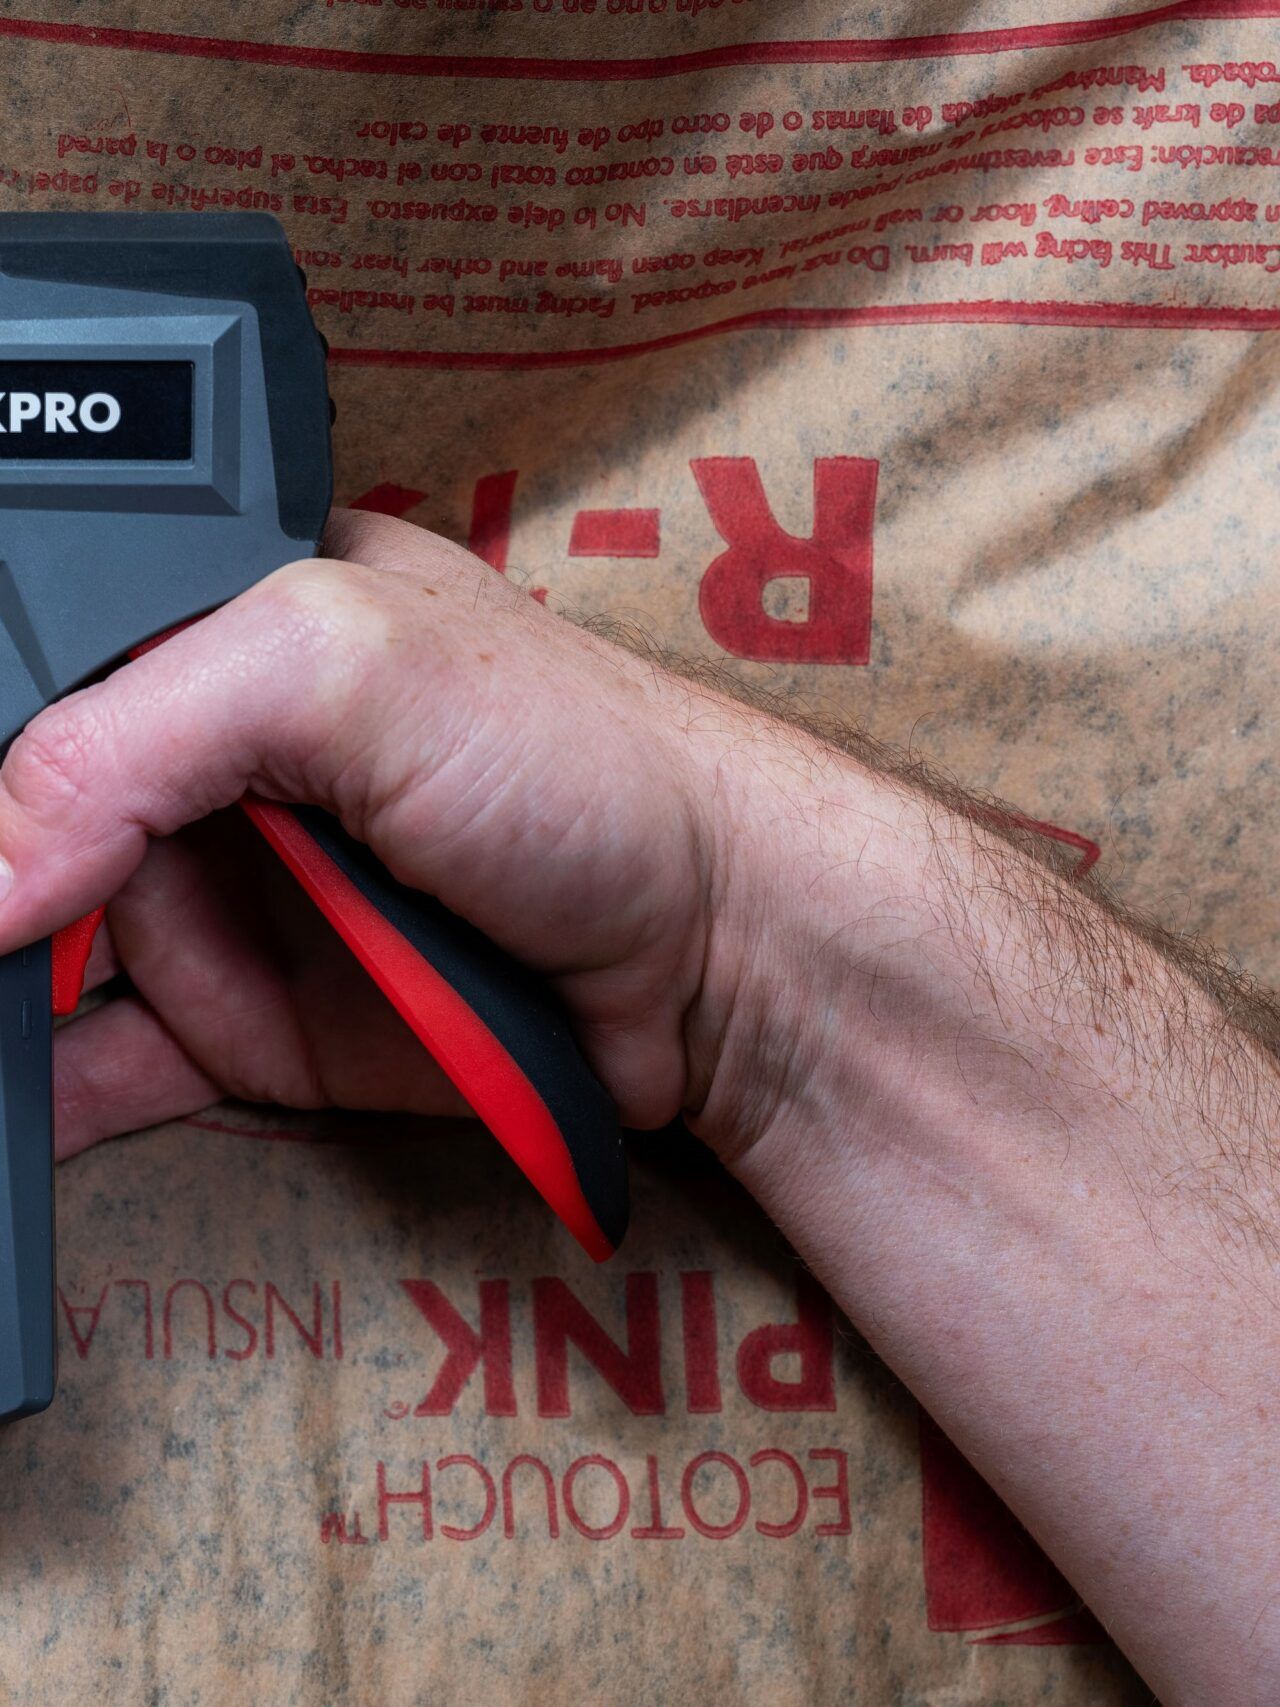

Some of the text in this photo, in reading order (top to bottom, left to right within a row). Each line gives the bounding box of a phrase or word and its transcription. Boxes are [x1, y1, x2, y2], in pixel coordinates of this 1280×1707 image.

[672, 113, 731, 133] otro
[782, 111, 803, 131] o
[812, 110, 897, 135] llamas
[902, 106, 932, 132] de
[1093, 106, 1124, 126] se
[1132, 104, 1201, 130] kraft
[1209, 103, 1245, 129] de
[1254, 101, 1280, 124] pa
[353, 119, 428, 147] calor.
[437, 124, 472, 149] de
[617, 119, 664, 144] tipo
[738, 112, 774, 139] de
[57, 134, 137, 157] pared
[481, 124, 569, 155] fuente
[577, 127, 611, 153] de
[146, 140, 168, 165] la
[176, 144, 197, 162] o
[206, 146, 262, 170] piso
[271, 154, 296, 176] el
[792, 146, 843, 173] que
[851, 143, 943, 170] manera
[1084, 145, 1143, 172] Este
[1150, 145, 1280, 171] recaución:
[397, 162, 421, 186] el
[430, 163, 482, 182] con
[491, 164, 556, 189] total
[565, 157, 674, 185] contacto
[683, 156, 717, 175] en
[726, 154, 783, 180] esté
[28, 169, 98, 196] papel
[108, 180, 141, 204] de
[828, 174, 905, 208] puede
[152, 182, 283, 211] superficie
[663, 195, 821, 222] incendiarse.
[294, 196, 348, 224] Esta
[367, 198, 497, 223] expuesto.
[508, 201, 566, 232] deje
[574, 207, 597, 230] lo
[604, 202, 647, 227] No
[873, 208, 923, 232] wall
[930, 206, 964, 223] or
[970, 204, 1037, 227] floor
[1142, 198, 1258, 227] approved
[295, 250, 342, 269] sou
[703, 246, 764, 268] Keep
[801, 251, 841, 272] not
[848, 245, 890, 272] Do
[905, 243, 974, 267] burn.
[981, 241, 1028, 266] will
[1035, 232, 1113, 268] facing
[1121, 241, 1175, 270] This
[351, 254, 409, 279] heat
[416, 257, 492, 281] other
[499, 260, 549, 282] and
[555, 259, 624, 283] flame
[632, 254, 695, 274] open
[423, 294, 455, 317] be
[463, 295, 529, 314] must
[534, 291, 616, 318] Facing
[631, 280, 737, 314] exposed.
[56, 1277, 344, 1361] INSULA
